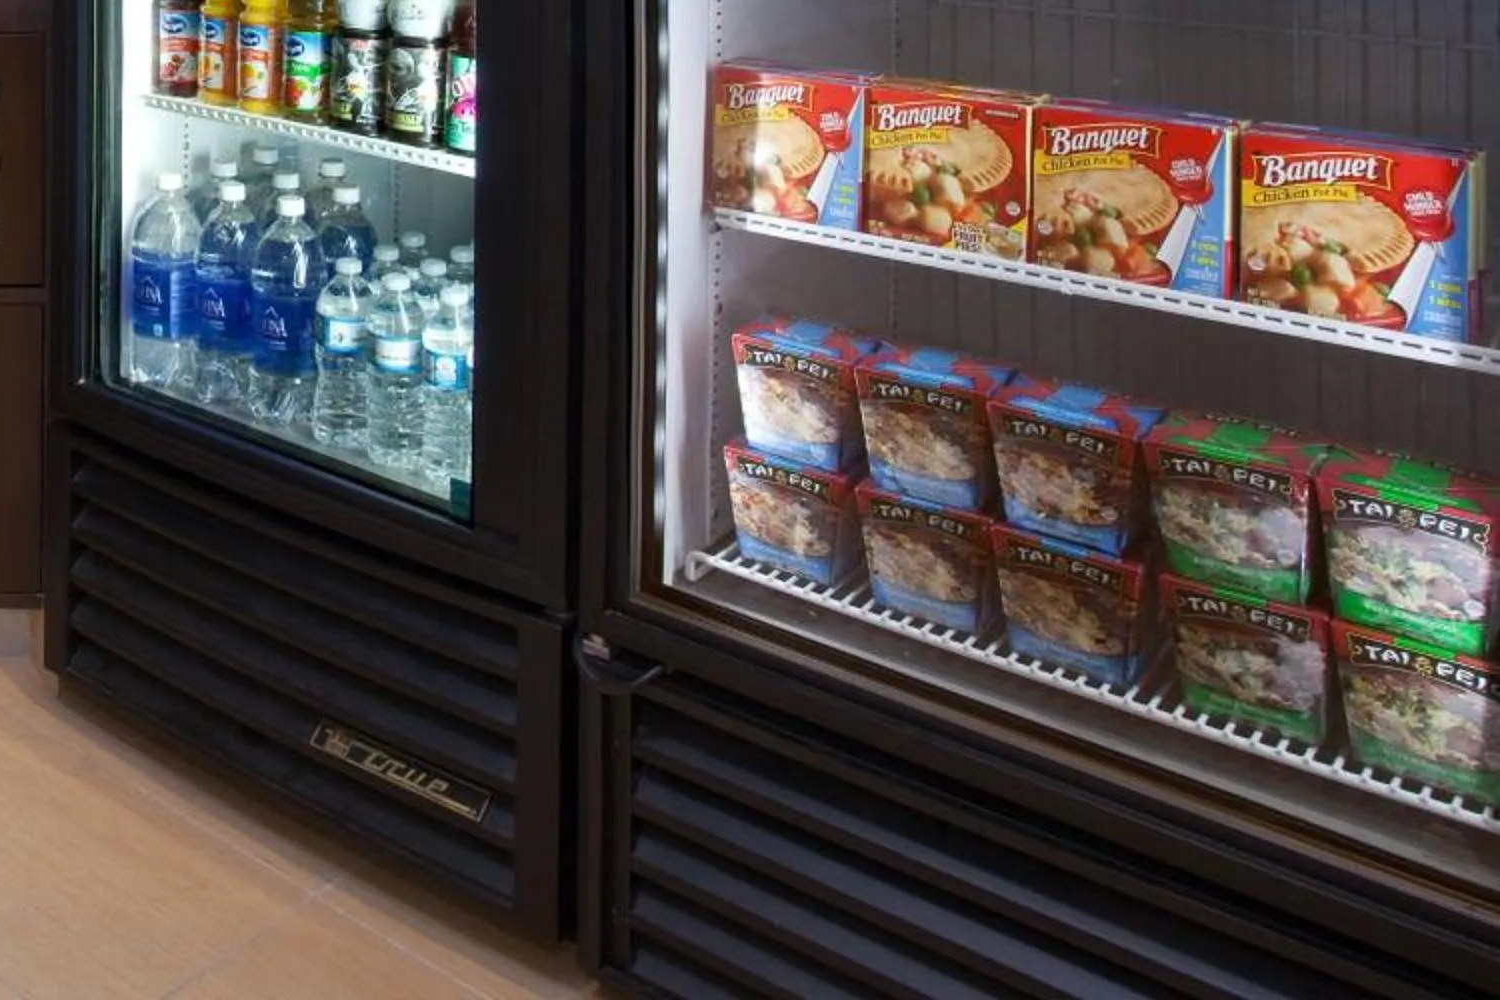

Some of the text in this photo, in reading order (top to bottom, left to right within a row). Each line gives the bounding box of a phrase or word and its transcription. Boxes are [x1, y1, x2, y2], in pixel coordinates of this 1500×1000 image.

[878, 104, 963, 131] Banquet
[1051, 126, 1150, 155] Banquet
[1042, 155, 1091, 171] Chicken
[1262, 155, 1380, 187] Banquet
[1253, 186, 1310, 204] Chicken
